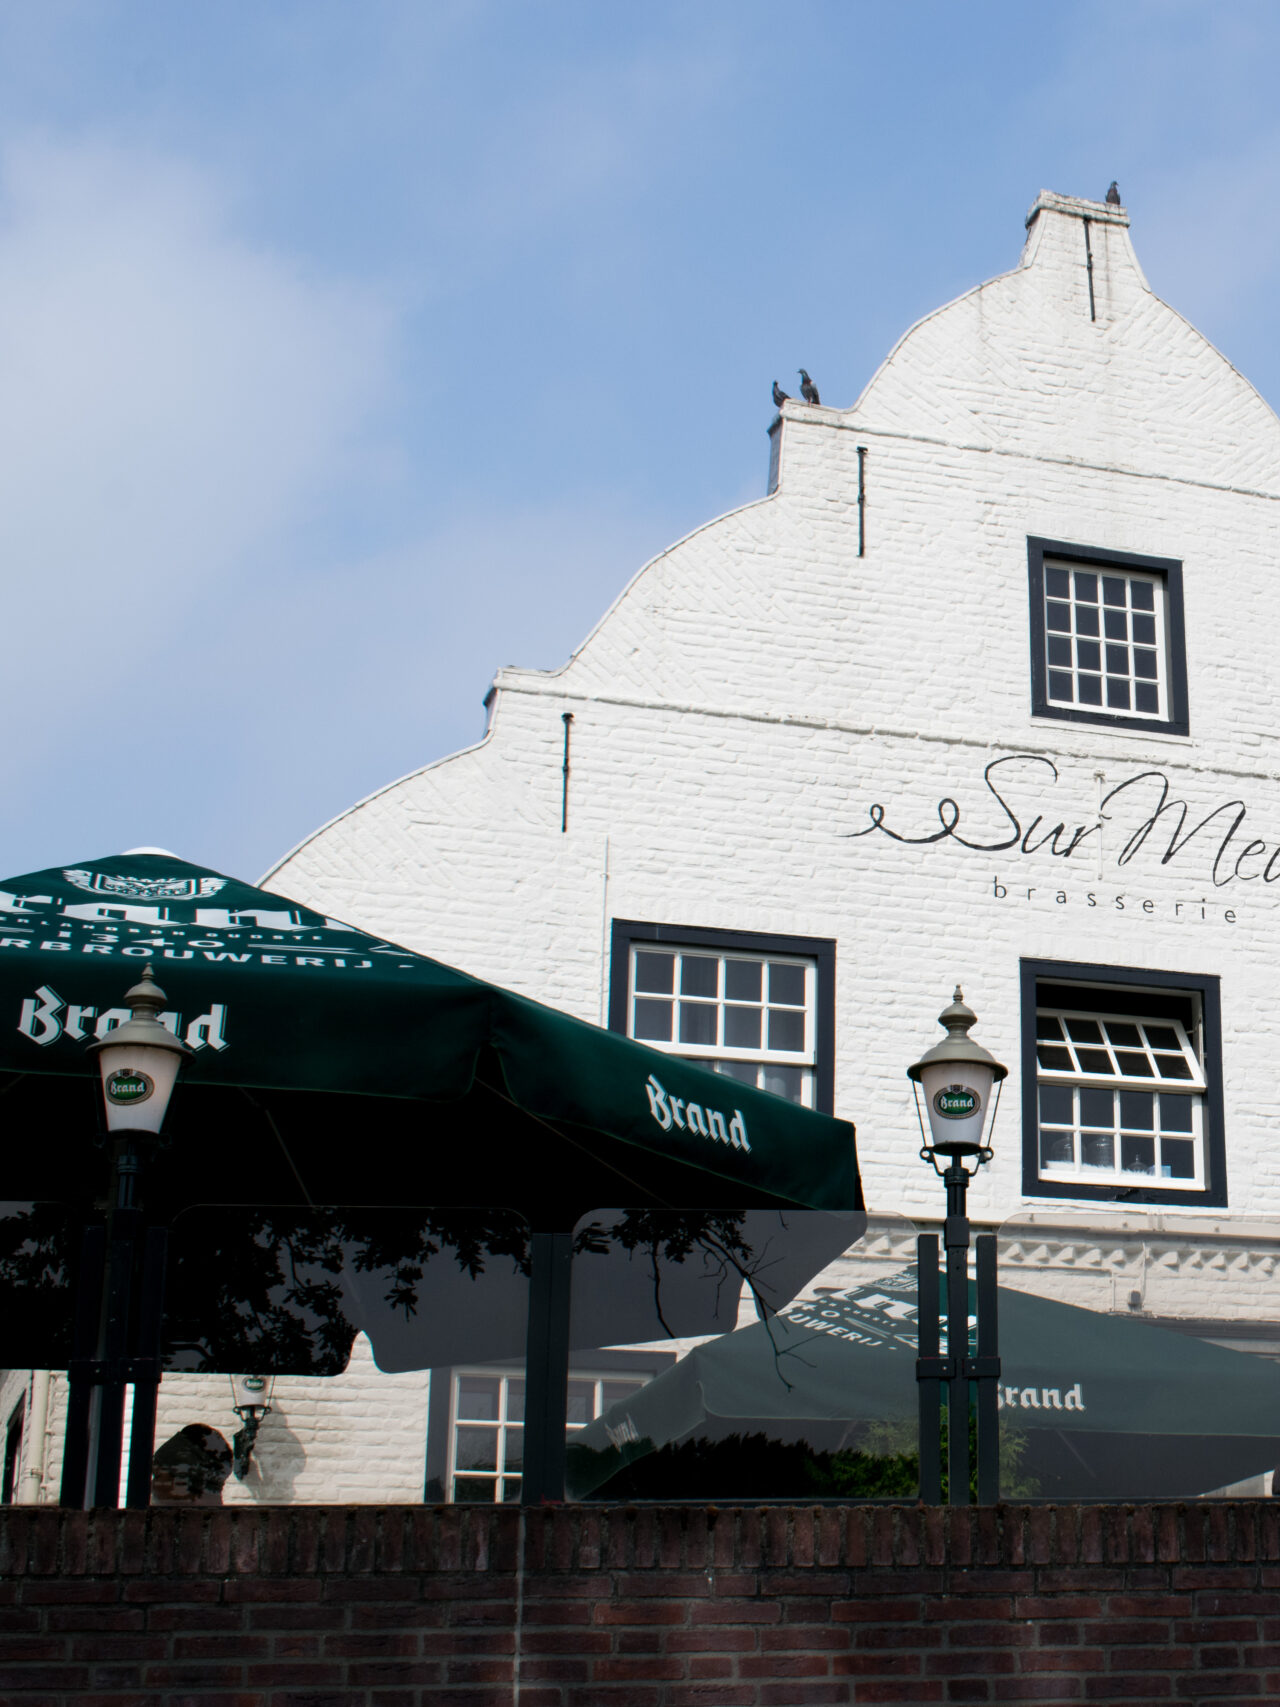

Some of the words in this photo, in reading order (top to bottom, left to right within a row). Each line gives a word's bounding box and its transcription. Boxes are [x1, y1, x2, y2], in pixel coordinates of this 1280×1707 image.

[994, 876, 1237, 923] brasserie
[110, 1080, 145, 1095] Brand
[940, 1096, 974, 1110] Brand
[645, 1073, 752, 1153] Brand
